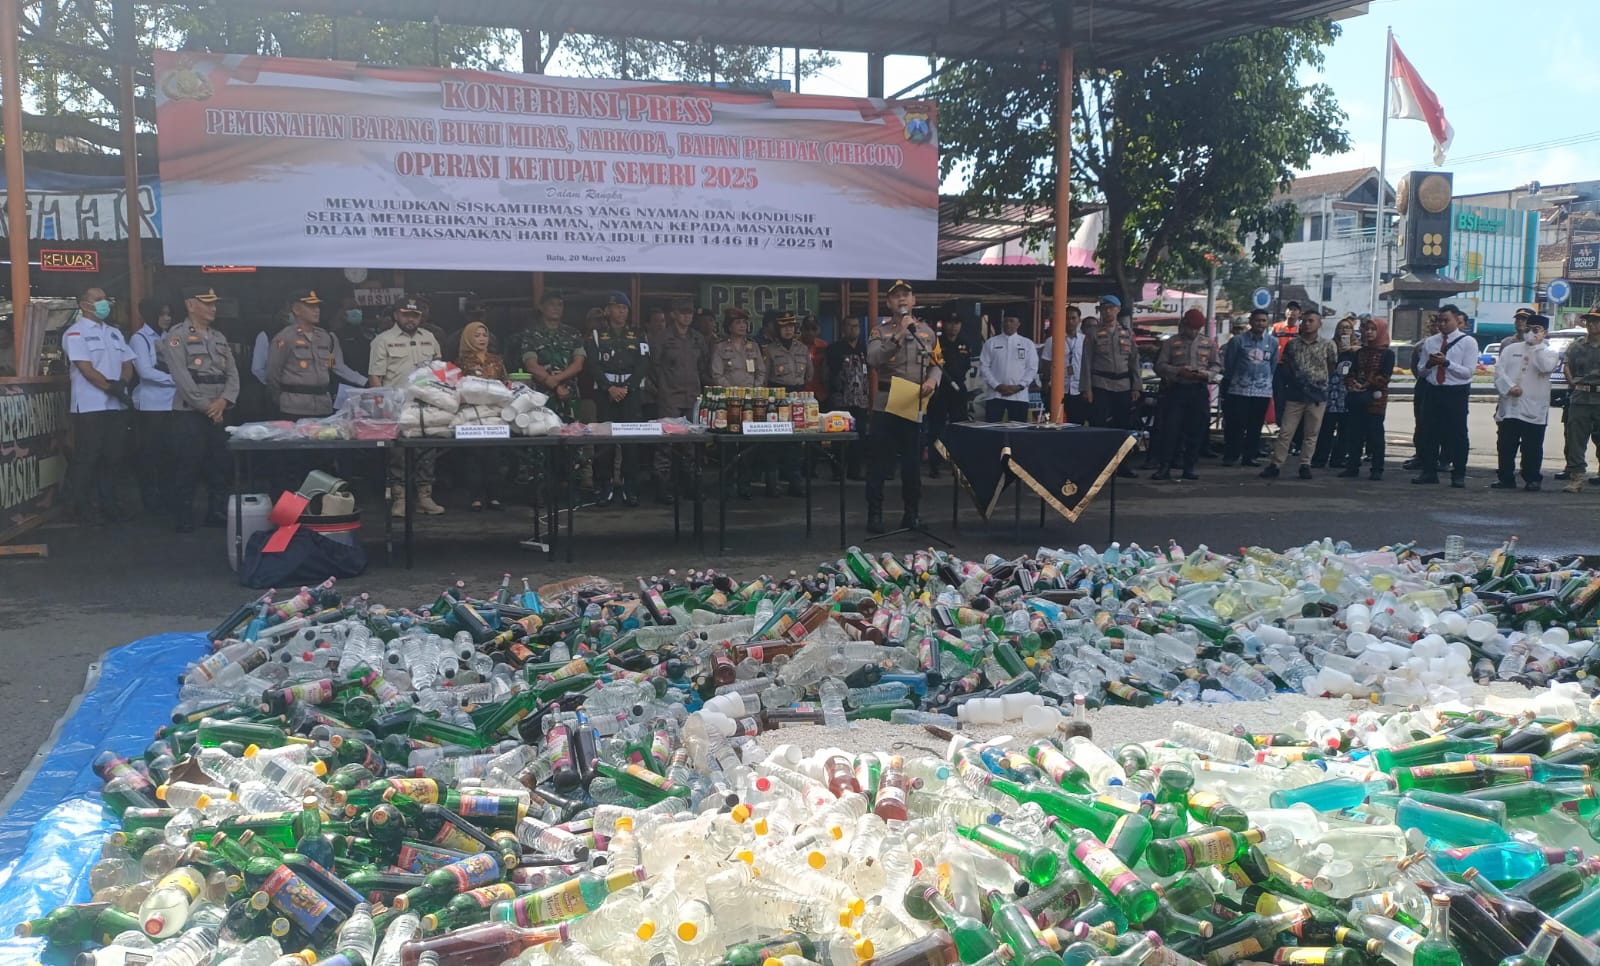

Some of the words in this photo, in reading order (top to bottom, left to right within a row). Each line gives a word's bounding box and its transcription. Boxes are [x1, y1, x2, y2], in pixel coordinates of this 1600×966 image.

[441, 79, 620, 120] KONFERENSI
[626, 94, 712, 126] PRESS
[205, 109, 345, 139] PEMUSNAHAN
[350, 116, 434, 144] BARANG
[439, 120, 502, 147] BUKTI
[507, 123, 575, 154] MIRAS,
[578, 128, 674, 158] NARKOBA,
[679, 132, 740, 159] BAHAN
[744, 137, 820, 162] PELEDAK
[824, 141, 903, 168] (MERCON)
[394, 151, 500, 180] OPERASI
[507, 156, 607, 185] KETUPAT
[614, 160, 697, 188] SEMERU
[704, 166, 759, 190] 2025
[546, 187, 581, 199] Dalam
[586, 189, 623, 201] Rangka
[306, 211, 365, 223] SERTA
[370, 213, 488, 226] MEMBERIKAN
[494, 217, 538, 228] RASA
[543, 218, 594, 230] AMAN,
[600, 220, 662, 231] NYAMAN
[669, 221, 731, 233] KEPADA
[736, 223, 833, 236] MASYARAKAT
[326, 198, 450, 212] MEWUJUDKAN
[456, 201, 583, 215] SISKAMTIBMAS
[589, 206, 631, 217] YANG
[637, 207, 699, 219] NYAMAN
[705, 210, 736, 221] DAN
[741, 211, 816, 224] KONDUSIF
[1458, 213, 1478, 231] BSI
[305, 225, 367, 237] DALAM
[373, 226, 512, 240] MELAKSANAKAN
[518, 230, 558, 241] HARI
[564, 231, 606, 242] RAYA
[611, 232, 648, 243] IDUL
[655, 233, 695, 244] FITRI
[702, 235, 743, 246] 1446
[748, 236, 759, 247] H
[763, 238, 770, 249] /
[776, 238, 816, 248] 2025
[821, 239, 833, 249] M
[546, 254, 568, 263] Batu,
[569, 254, 580, 263] 20
[582, 254, 603, 263] Maret
[605, 255, 626, 263] 2025
[0, 393, 36, 442] EPEDA
